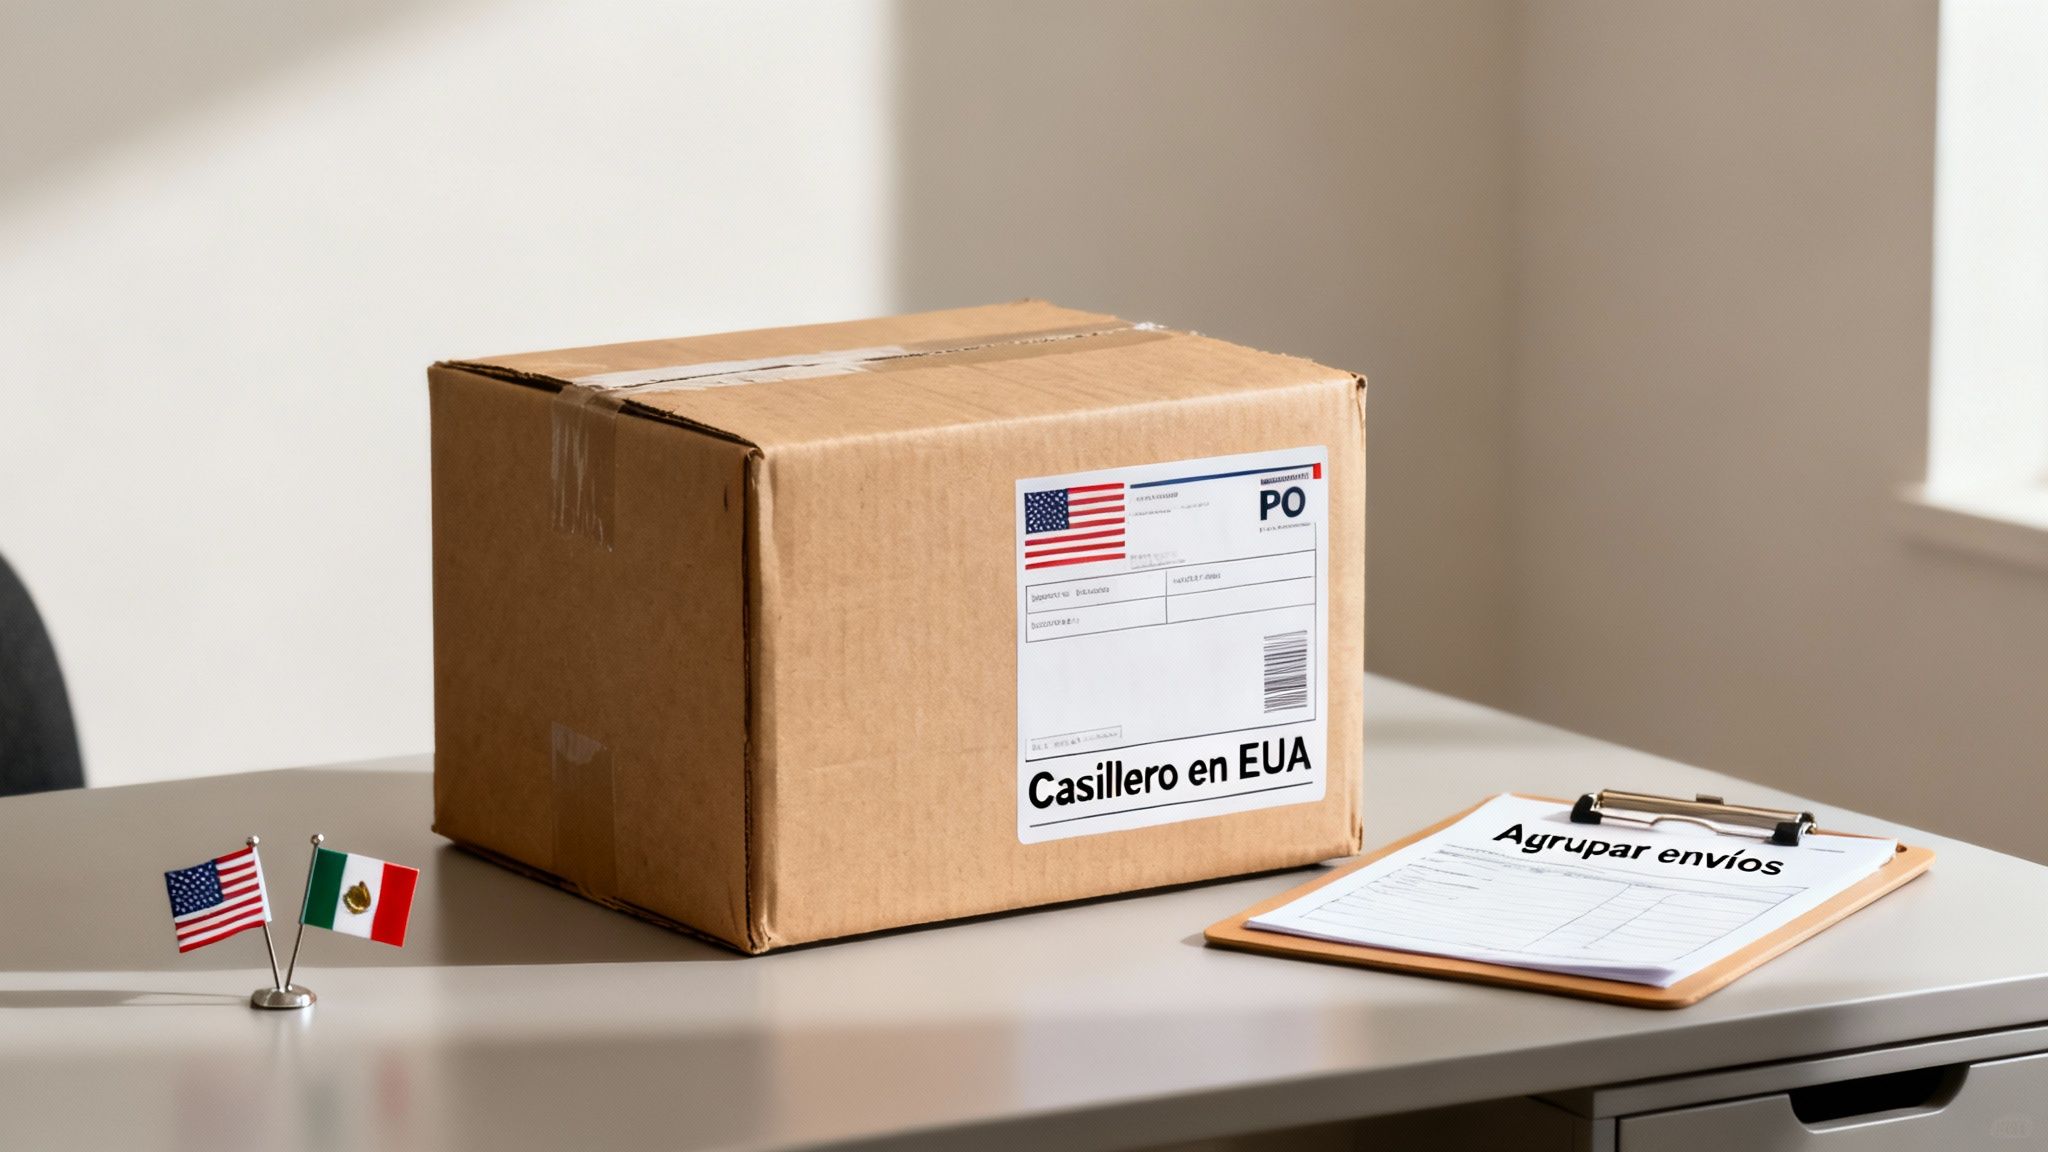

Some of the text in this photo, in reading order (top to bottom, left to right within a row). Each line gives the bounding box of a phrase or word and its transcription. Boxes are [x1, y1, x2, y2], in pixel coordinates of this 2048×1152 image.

[1260, 486, 1306, 521] PO
[1028, 736, 1312, 810] Casillero en EUA
[1492, 823, 1652, 861] Agrupar
[1657, 848, 1785, 876] envíos
